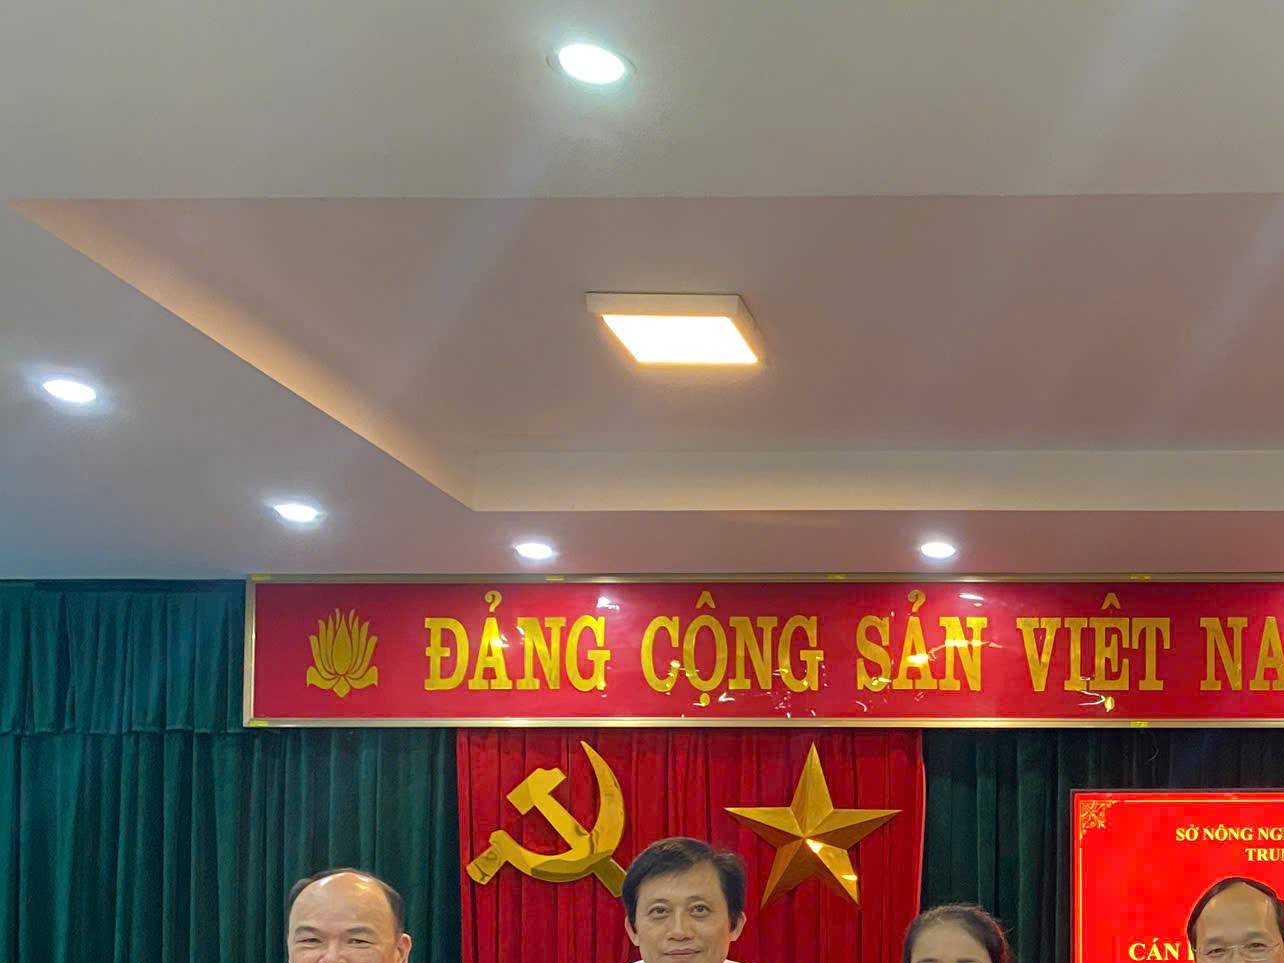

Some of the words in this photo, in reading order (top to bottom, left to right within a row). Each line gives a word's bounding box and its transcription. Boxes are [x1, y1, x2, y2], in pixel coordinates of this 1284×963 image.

[424, 590, 611, 692] ĐẢNG
[640, 590, 825, 707] CỘNG
[856, 590, 988, 692] SẢN
[1016, 592, 1170, 712] VIỆT
[1175, 824, 1199, 842] SỞ
[1203, 824, 1253, 841] NÔNG
[1128, 937, 1181, 961] CÁN
